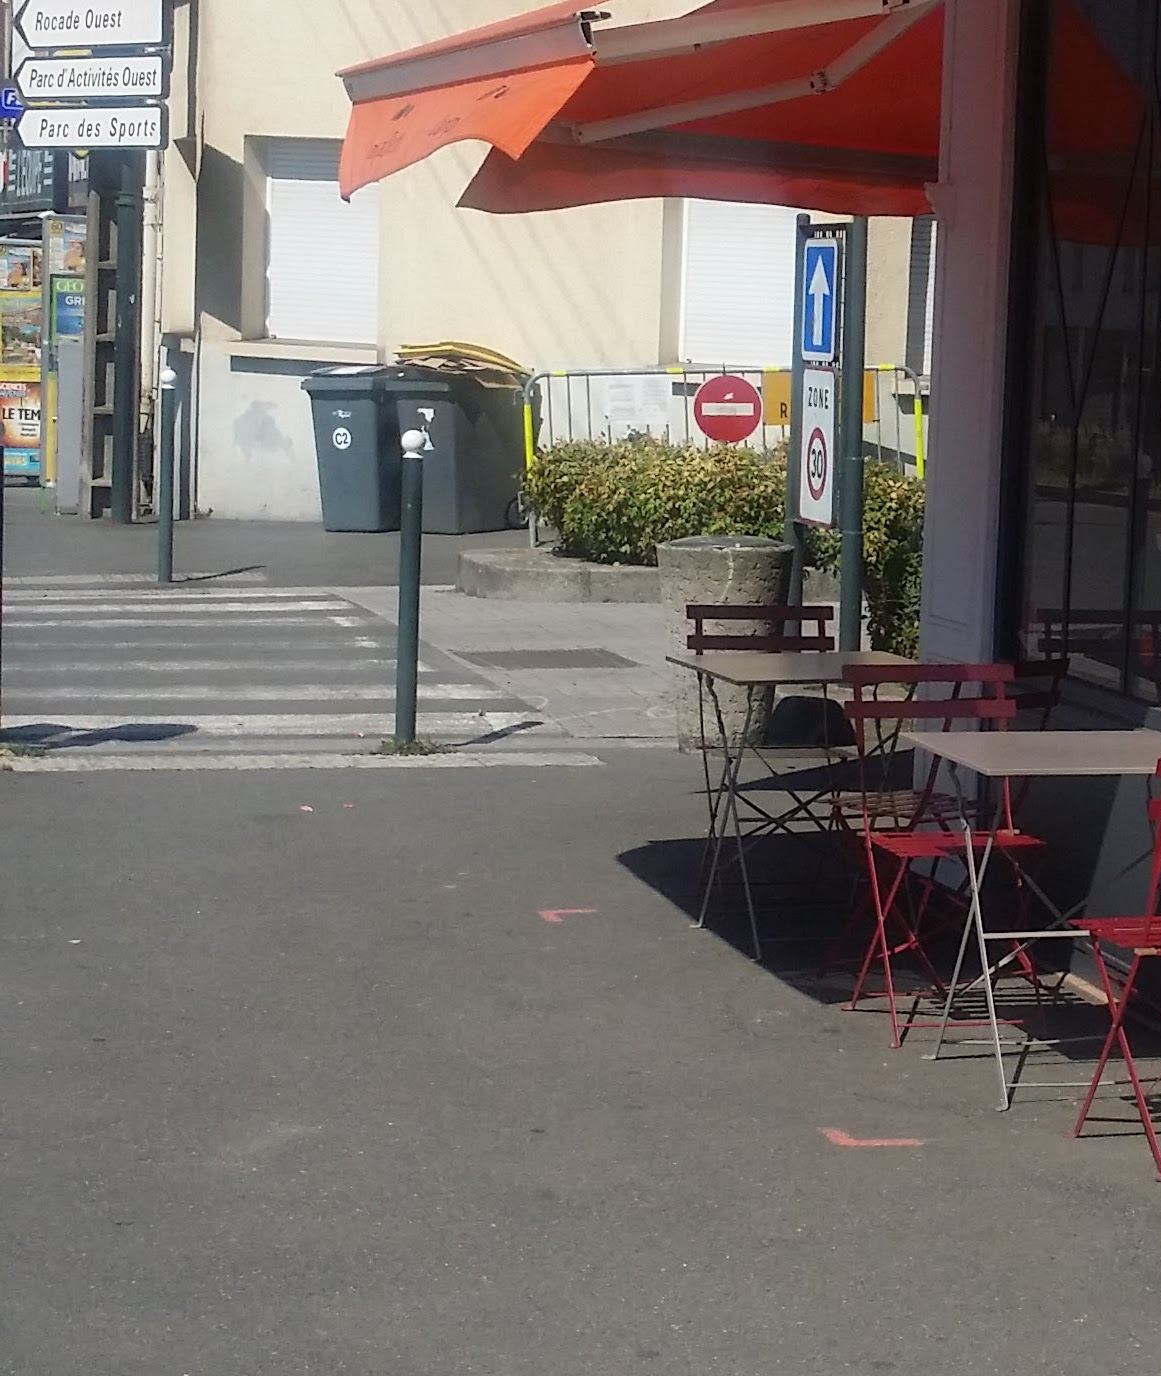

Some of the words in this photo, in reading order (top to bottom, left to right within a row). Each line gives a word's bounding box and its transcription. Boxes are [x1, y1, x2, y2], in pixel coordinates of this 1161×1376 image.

[35, 10, 80, 31] Rocade
[85, 9, 122, 29] Ouest
[29, 68, 55, 88] Parc
[57, 66, 119, 88] d'Activités
[122, 66, 157, 87] Ouest
[39, 118, 69, 138] Parc
[77, 118, 100, 138] des
[109, 117, 157, 142] Sports
[56, 279, 84, 293] GEO
[808, 386, 829, 410] ZONE
[2, 407, 15, 420] LE
[335, 432, 349, 445] C2
[811, 448, 823, 479] 30
